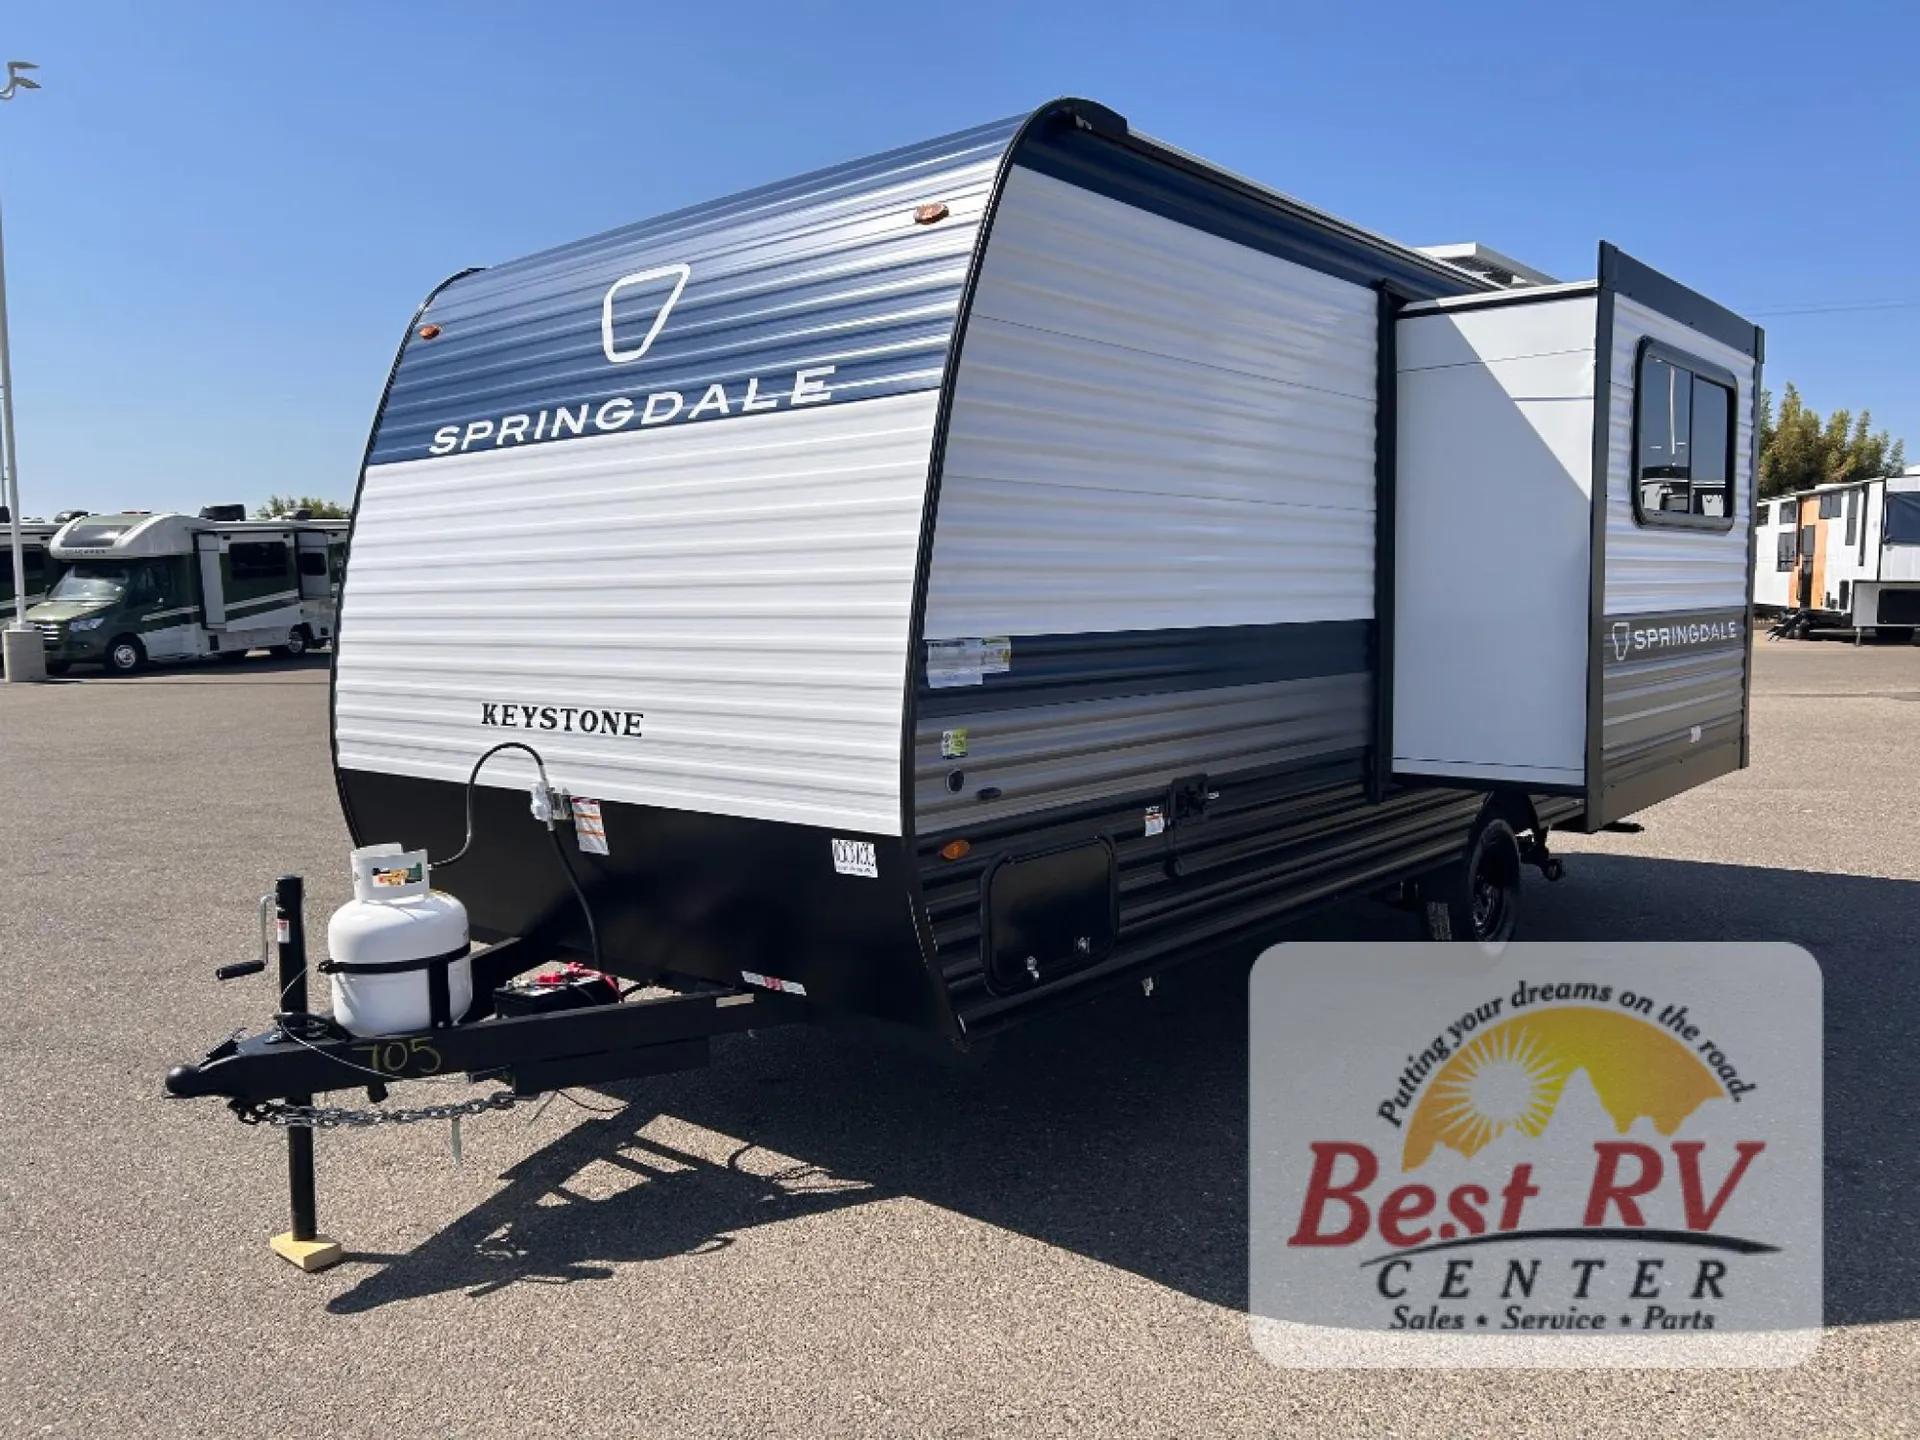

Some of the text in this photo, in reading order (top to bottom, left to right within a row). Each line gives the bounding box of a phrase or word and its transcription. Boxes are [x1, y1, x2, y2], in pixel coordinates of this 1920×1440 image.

[429, 364, 837, 455] SPRINGDALE
[1634, 621, 1737, 650] SPRINGDALE
[481, 702, 644, 737] KEYSTONE
[351, 1037, 441, 1073] 705
